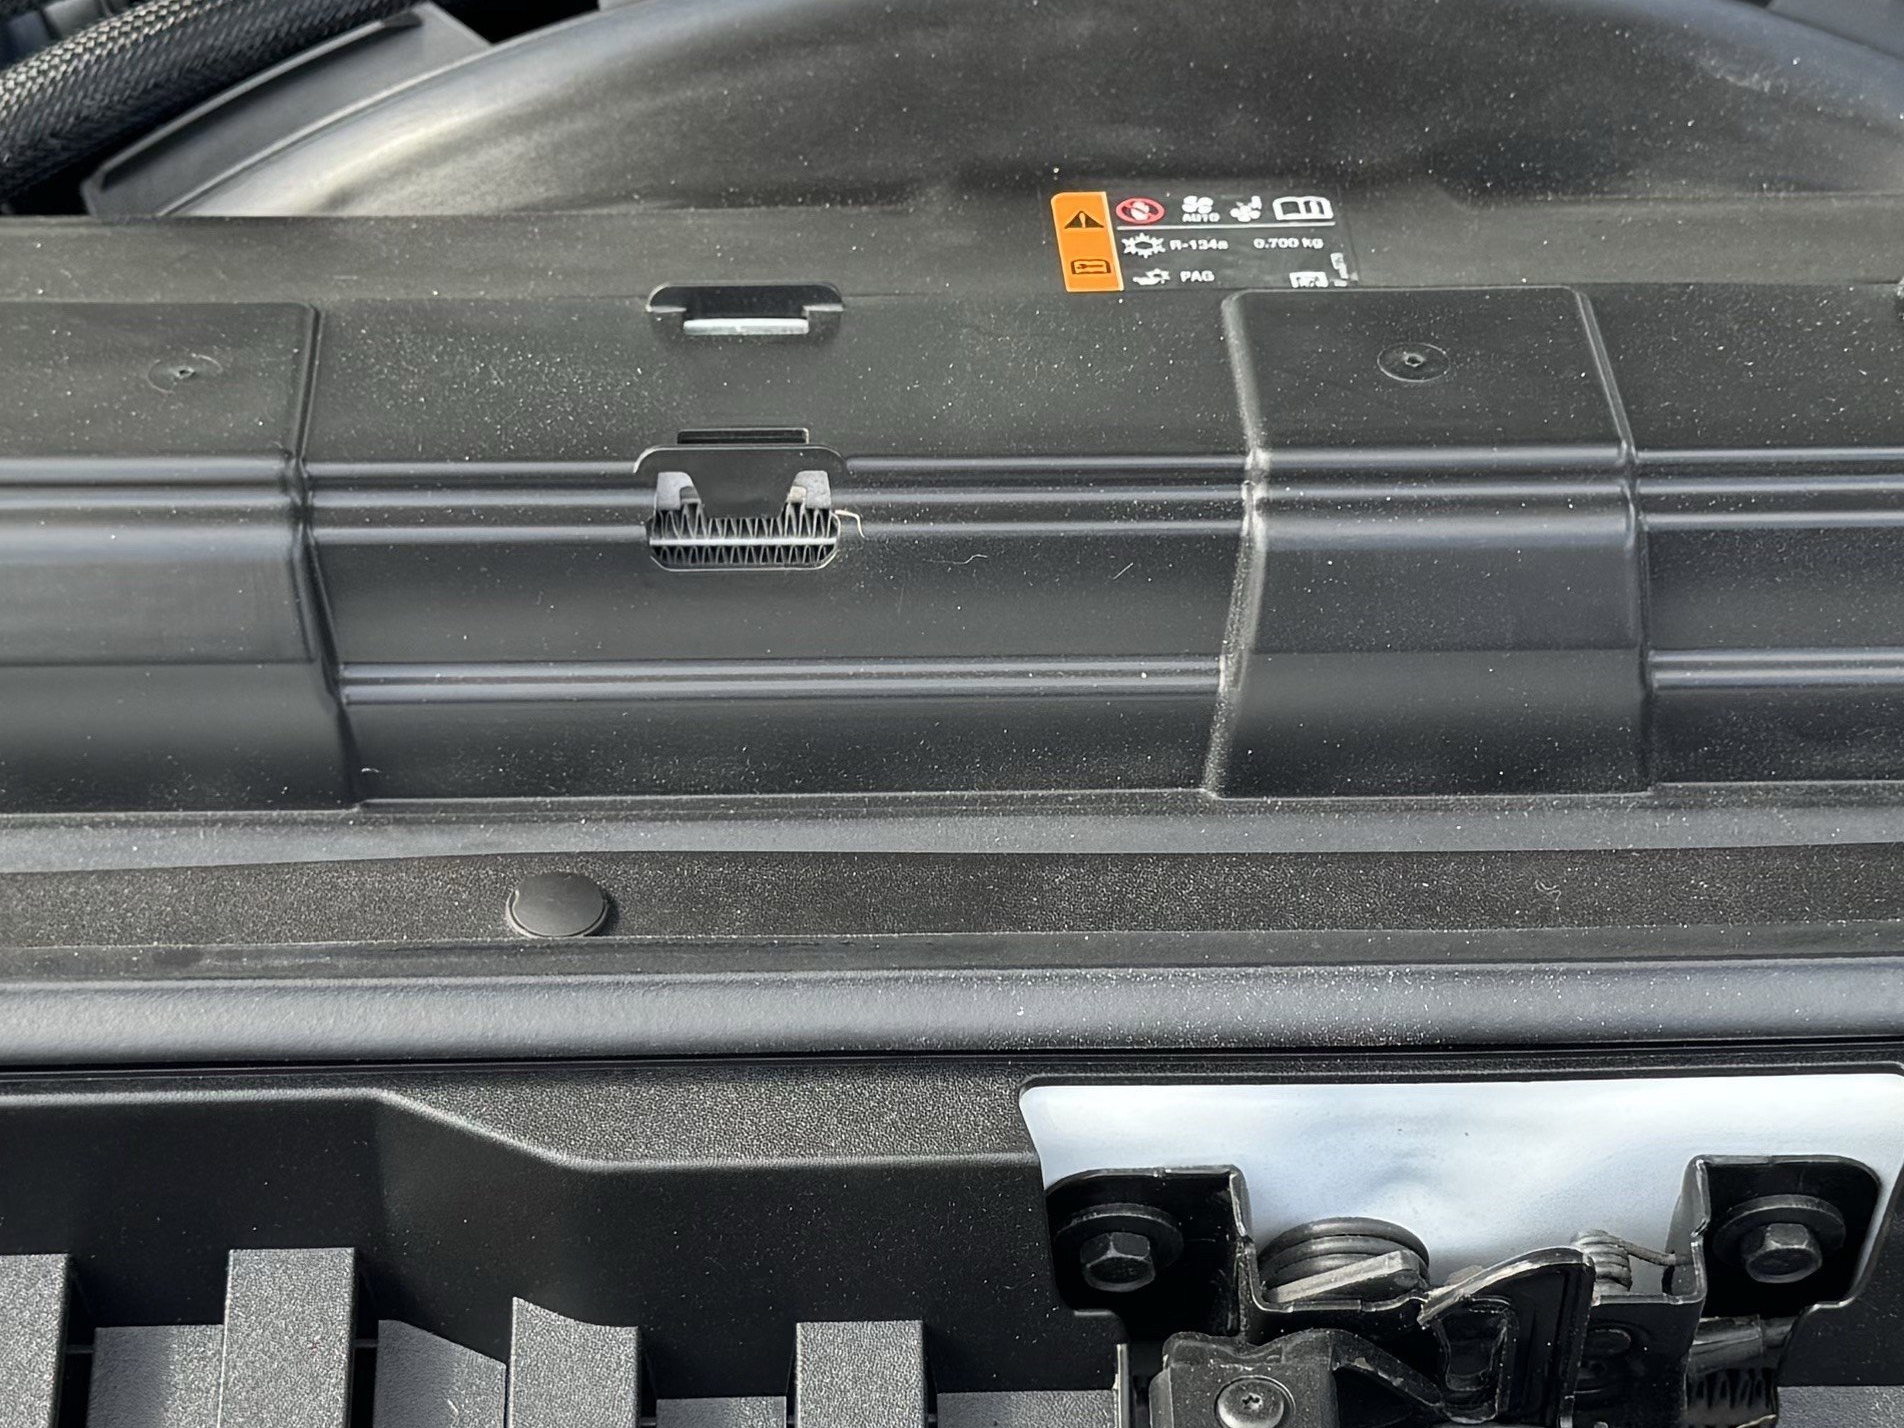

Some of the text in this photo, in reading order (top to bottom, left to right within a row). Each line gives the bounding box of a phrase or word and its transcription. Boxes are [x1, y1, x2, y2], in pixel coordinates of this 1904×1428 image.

[1182, 212, 1220, 222] AUTO
[1169, 238, 1229, 250] R-134a
[1253, 237, 1299, 249] 0.700
[1180, 270, 1215, 282] PAG
